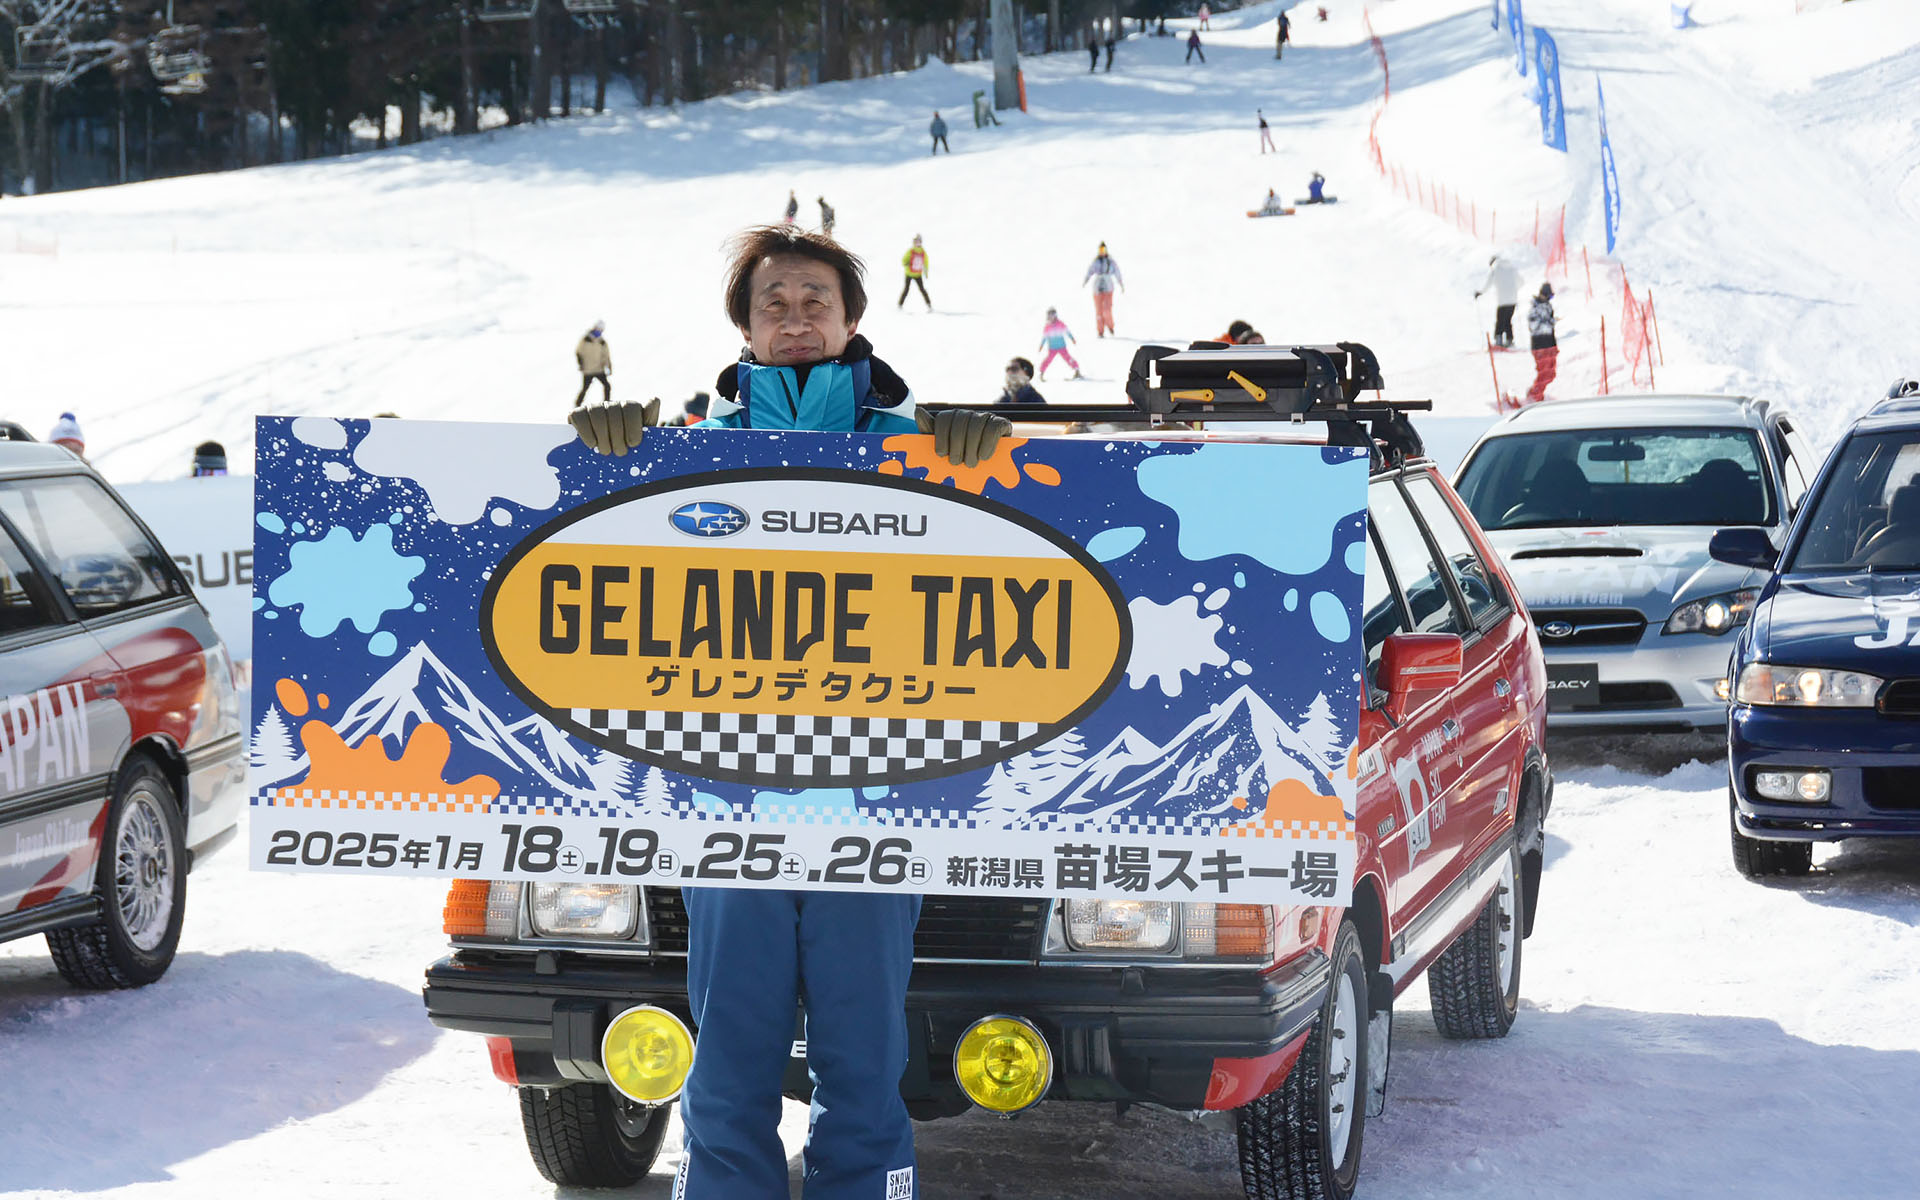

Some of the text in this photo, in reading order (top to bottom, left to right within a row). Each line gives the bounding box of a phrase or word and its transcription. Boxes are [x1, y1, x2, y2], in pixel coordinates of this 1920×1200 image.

[761, 509, 929, 537] SUBARU
[540, 564, 1074, 670] GELANDE TAXI
[646, 664, 976, 705] ゲレンデタクシー
[266, 830, 484, 870] 2025年1月
[946, 856, 1044, 889] 新潟県
[1054, 843, 1339, 898] 苗場スキー場
[888, 1183, 911, 1199] JAPAN
[889, 1171, 911, 1187] SNOW
